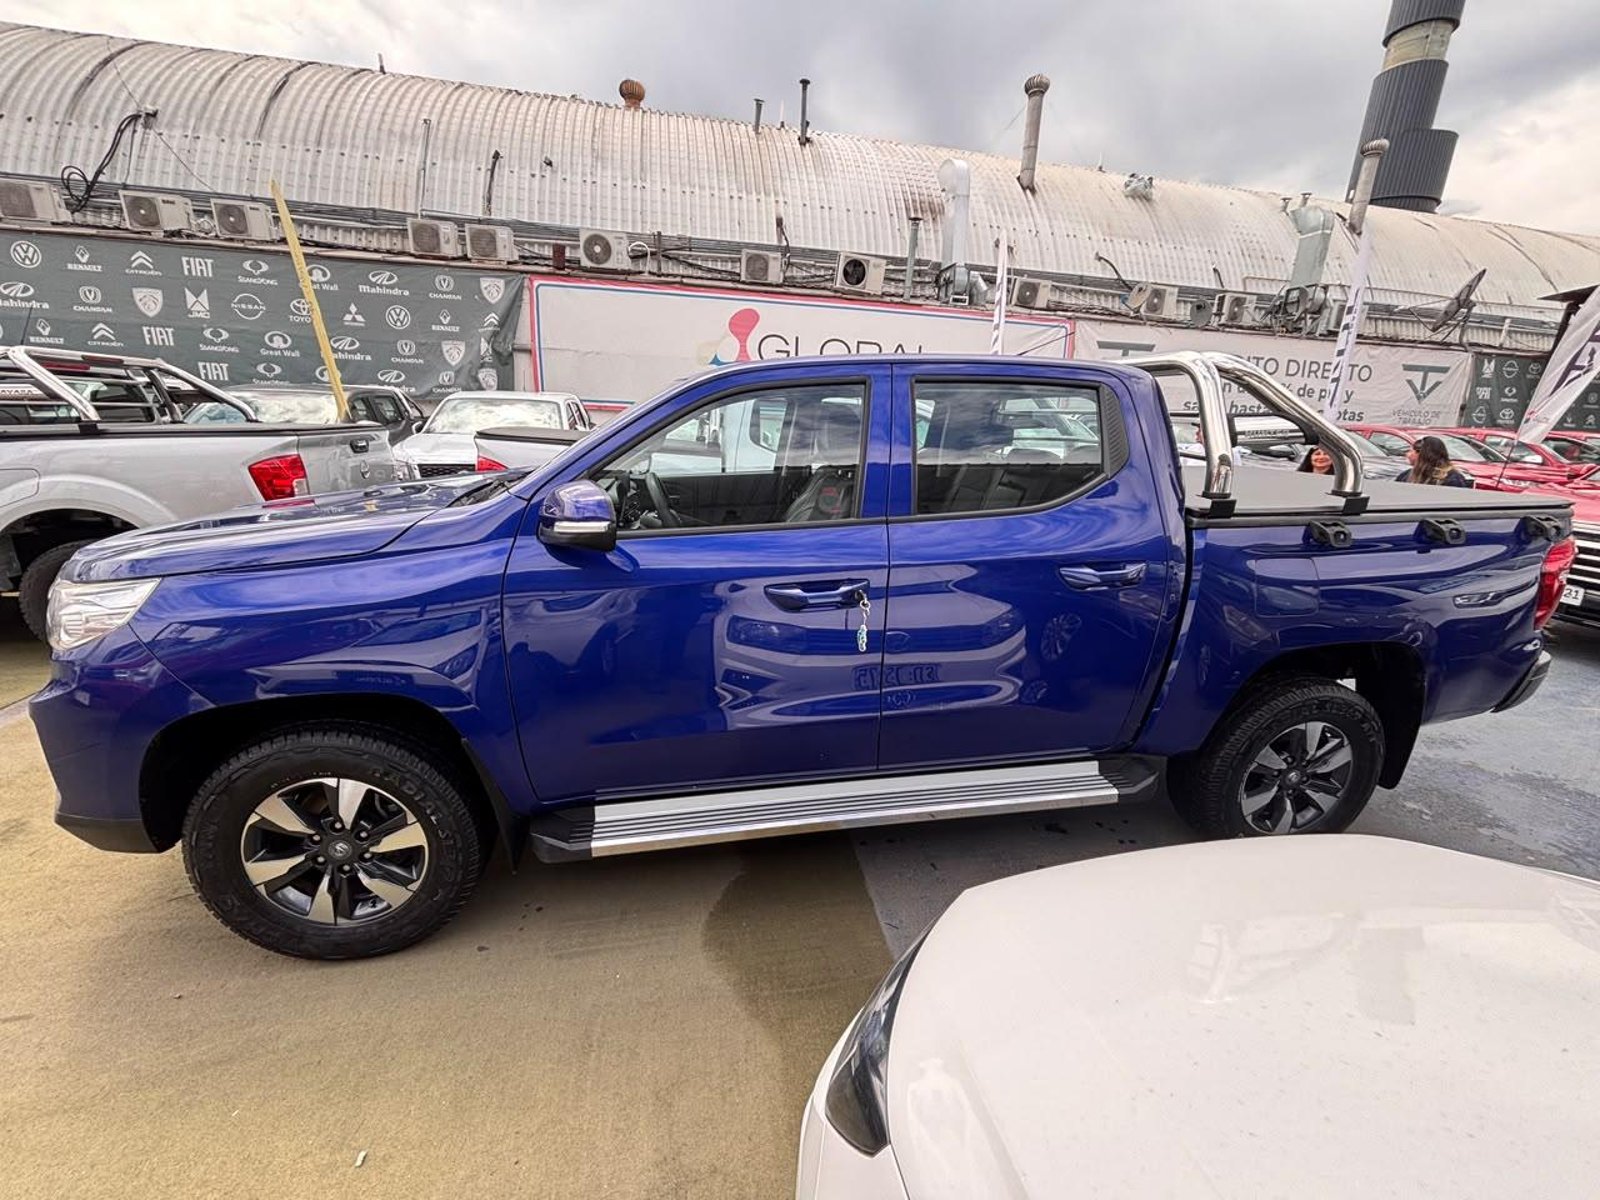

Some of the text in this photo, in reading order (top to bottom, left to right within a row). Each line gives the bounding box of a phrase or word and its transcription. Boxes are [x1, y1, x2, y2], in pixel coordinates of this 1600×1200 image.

[181, 256, 214, 278] FIAT
[358, 284, 410, 297] Mahindra
[0, 299, 50, 310] ahindra
[230, 302, 267, 311] NISSAN
[288, 315, 312, 323] TOYO
[142, 326, 175, 347] FIAT
[197, 362, 229, 381] FIAT
[1285, 358, 1373, 383] DIRETO
[1297, 383, 1315, 398] de
